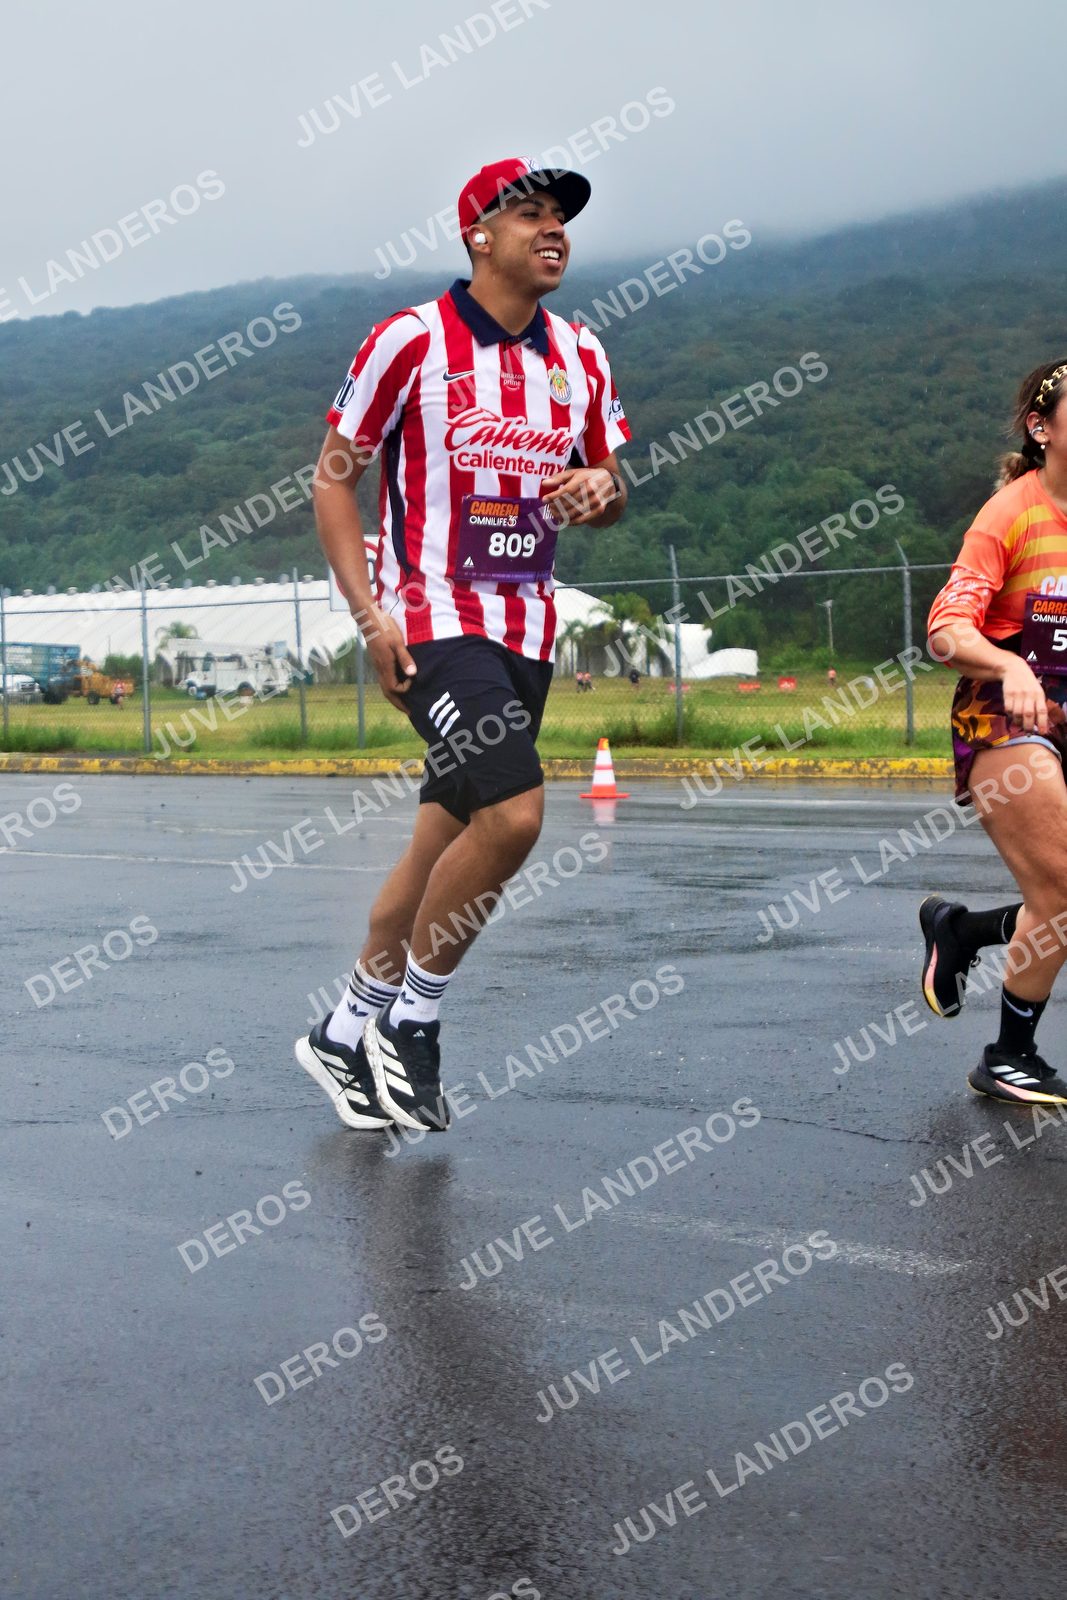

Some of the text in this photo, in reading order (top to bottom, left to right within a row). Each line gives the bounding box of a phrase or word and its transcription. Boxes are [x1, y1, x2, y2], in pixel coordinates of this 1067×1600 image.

[444, 407, 574, 457] Caliente
[470, 501, 519, 516] CARRERA
[469, 515, 508, 526] OMNILIFE
[488, 532, 536, 557] 809
[1032, 613, 1067, 624] OMNILIF
